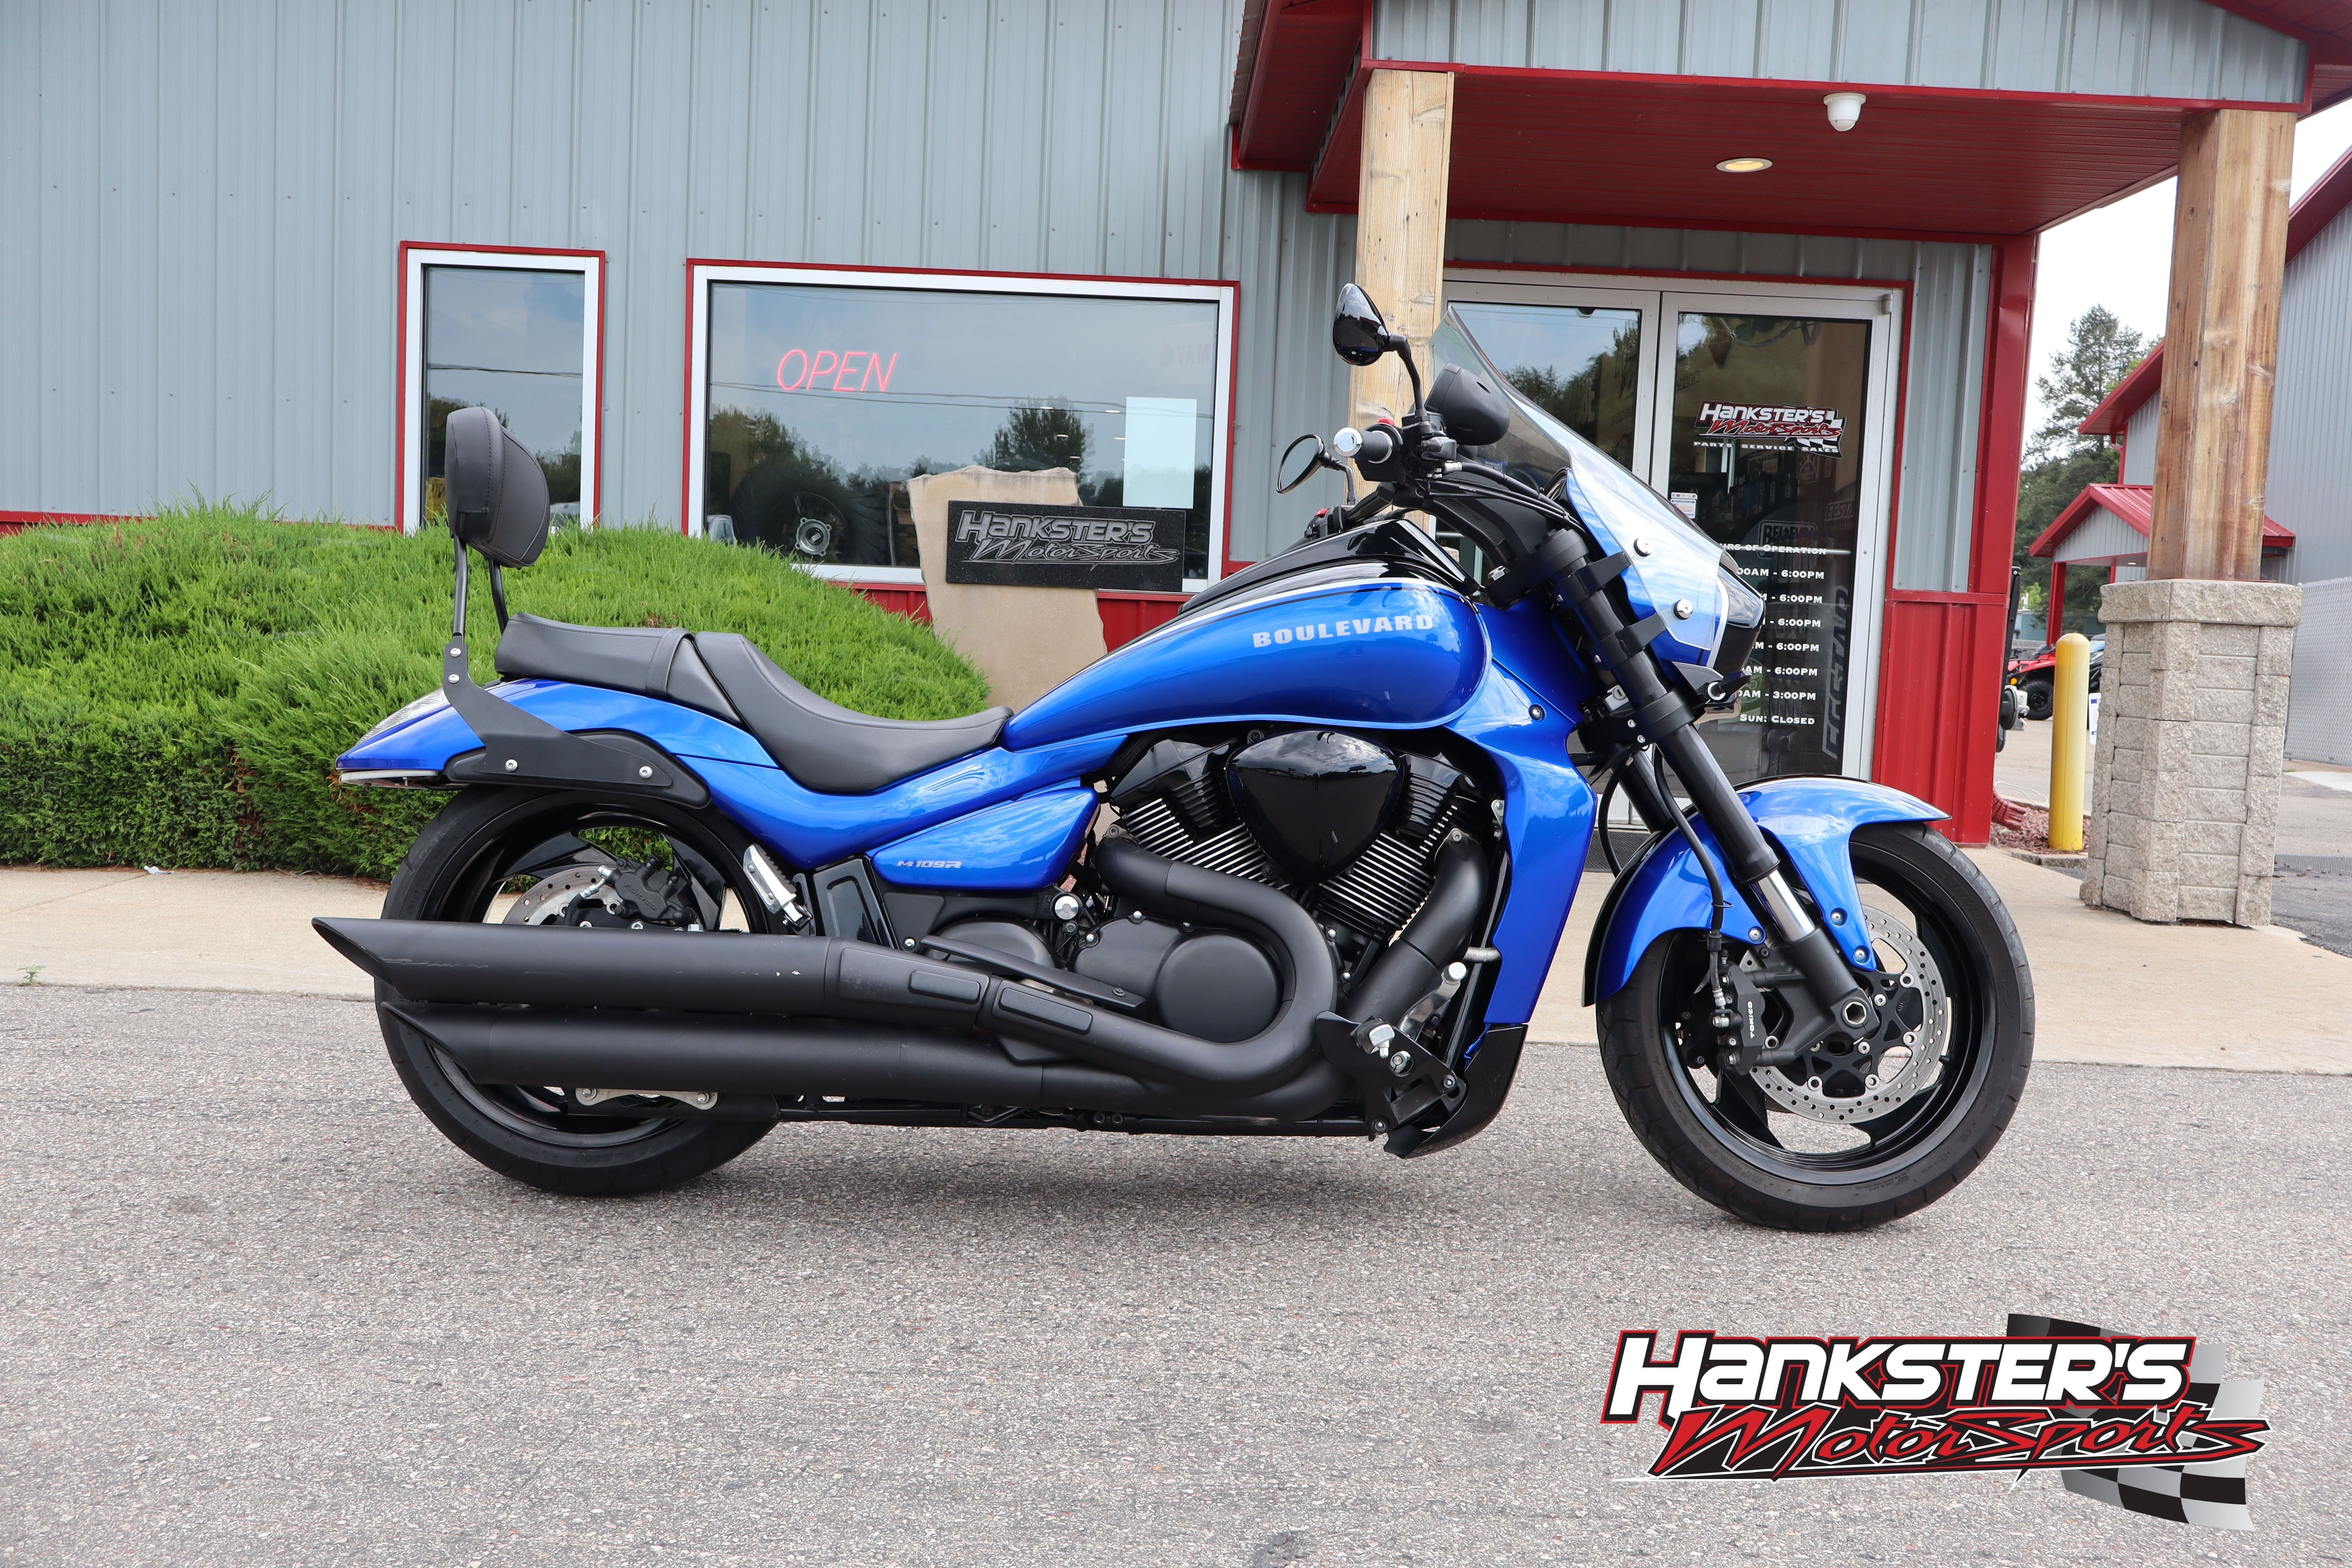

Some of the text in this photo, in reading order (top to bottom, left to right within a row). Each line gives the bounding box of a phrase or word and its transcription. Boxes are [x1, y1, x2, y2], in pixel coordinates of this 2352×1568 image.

[777, 348, 898, 392] OPEN
[1763, 544, 1826, 555] OPERATION
[1737, 567, 1769, 577] 00AM
[1781, 570, 1825, 579] 6:00PM
[1779, 594, 1823, 604] 6:00PM
[1778, 618, 1821, 628] 6:00PM
[1252, 614, 1434, 648] BOULEVARD
[1776, 642, 1819, 652] 6:00PM
[1775, 667, 1818, 676] 6:00PM
[1773, 691, 1816, 701] 3:00PM
[1740, 714, 1815, 724] SUN: CLOSED
[624, 881, 657, 911] TOKICO
[1935, 868, 1990, 928] DUNLOP
[1747, 1001, 1756, 1039] TOKICO
